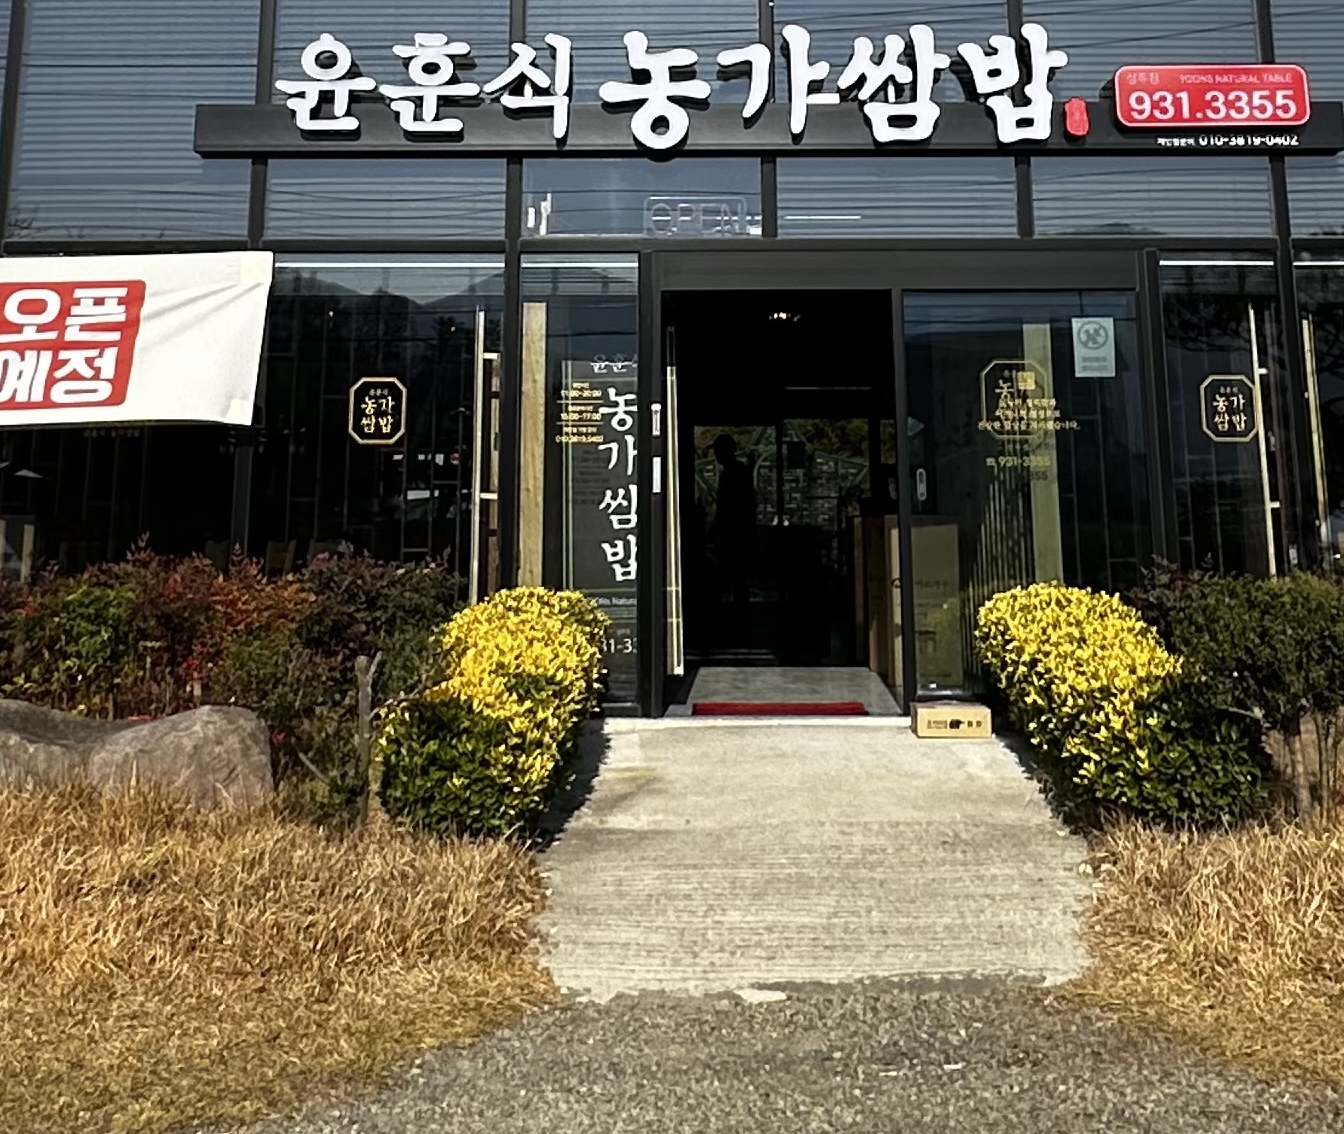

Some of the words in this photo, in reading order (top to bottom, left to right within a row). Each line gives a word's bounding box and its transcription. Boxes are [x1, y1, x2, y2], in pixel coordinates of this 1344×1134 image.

[274, 32, 572, 139] 윤훈식
[599, 23, 1069, 150] 농가쌈밥
[1262, 72, 1292, 83] TABLE
[1128, 89, 1297, 120] 931.3355
[361, 395, 396, 415] 농가
[1212, 394, 1246, 412] 농가
[360, 415, 394, 434] 쌈밥
[1213, 412, 1247, 431] 쌈밥
